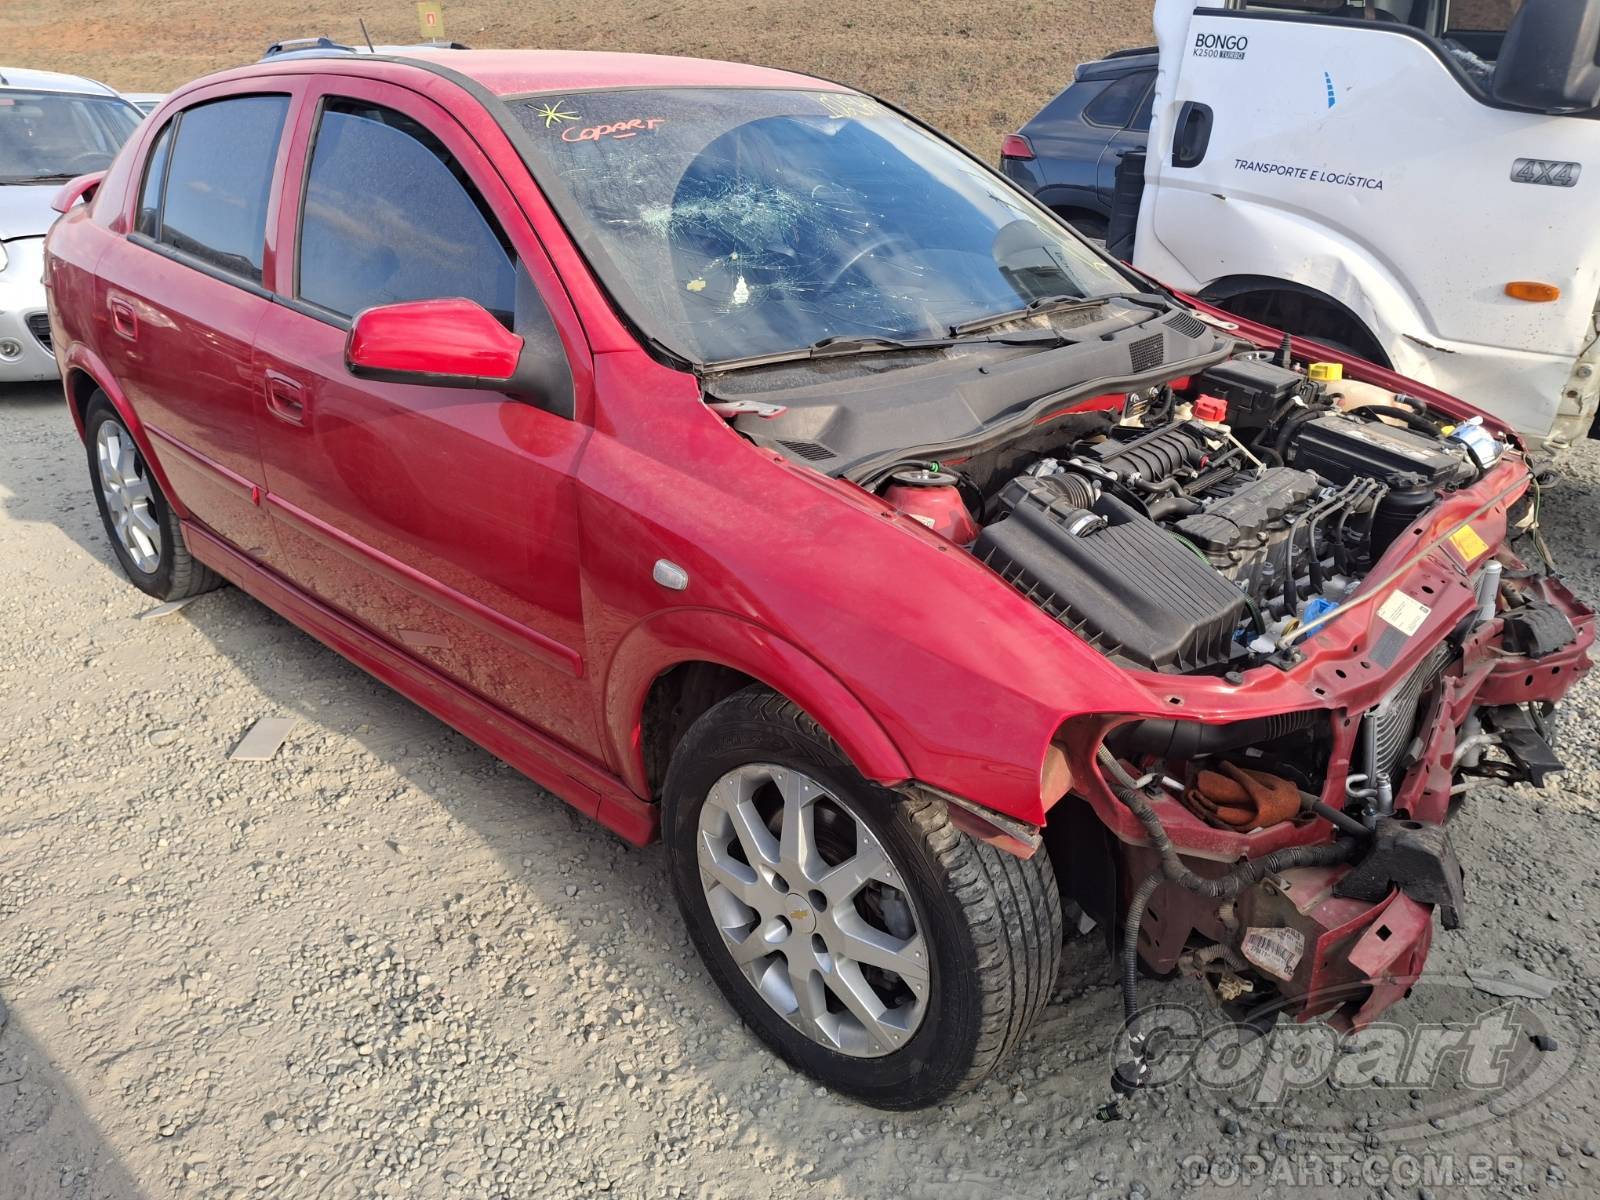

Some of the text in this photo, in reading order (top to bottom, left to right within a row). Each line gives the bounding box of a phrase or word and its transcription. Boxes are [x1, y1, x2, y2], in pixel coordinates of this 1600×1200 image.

[1195, 33, 1248, 51] BONGO
[1193, 48, 1245, 60] K2500 TURBO
[1234, 158, 1384, 191] TRANSPORTE E LOGÍSTICA
[1516, 160, 1574, 186] 4X4
